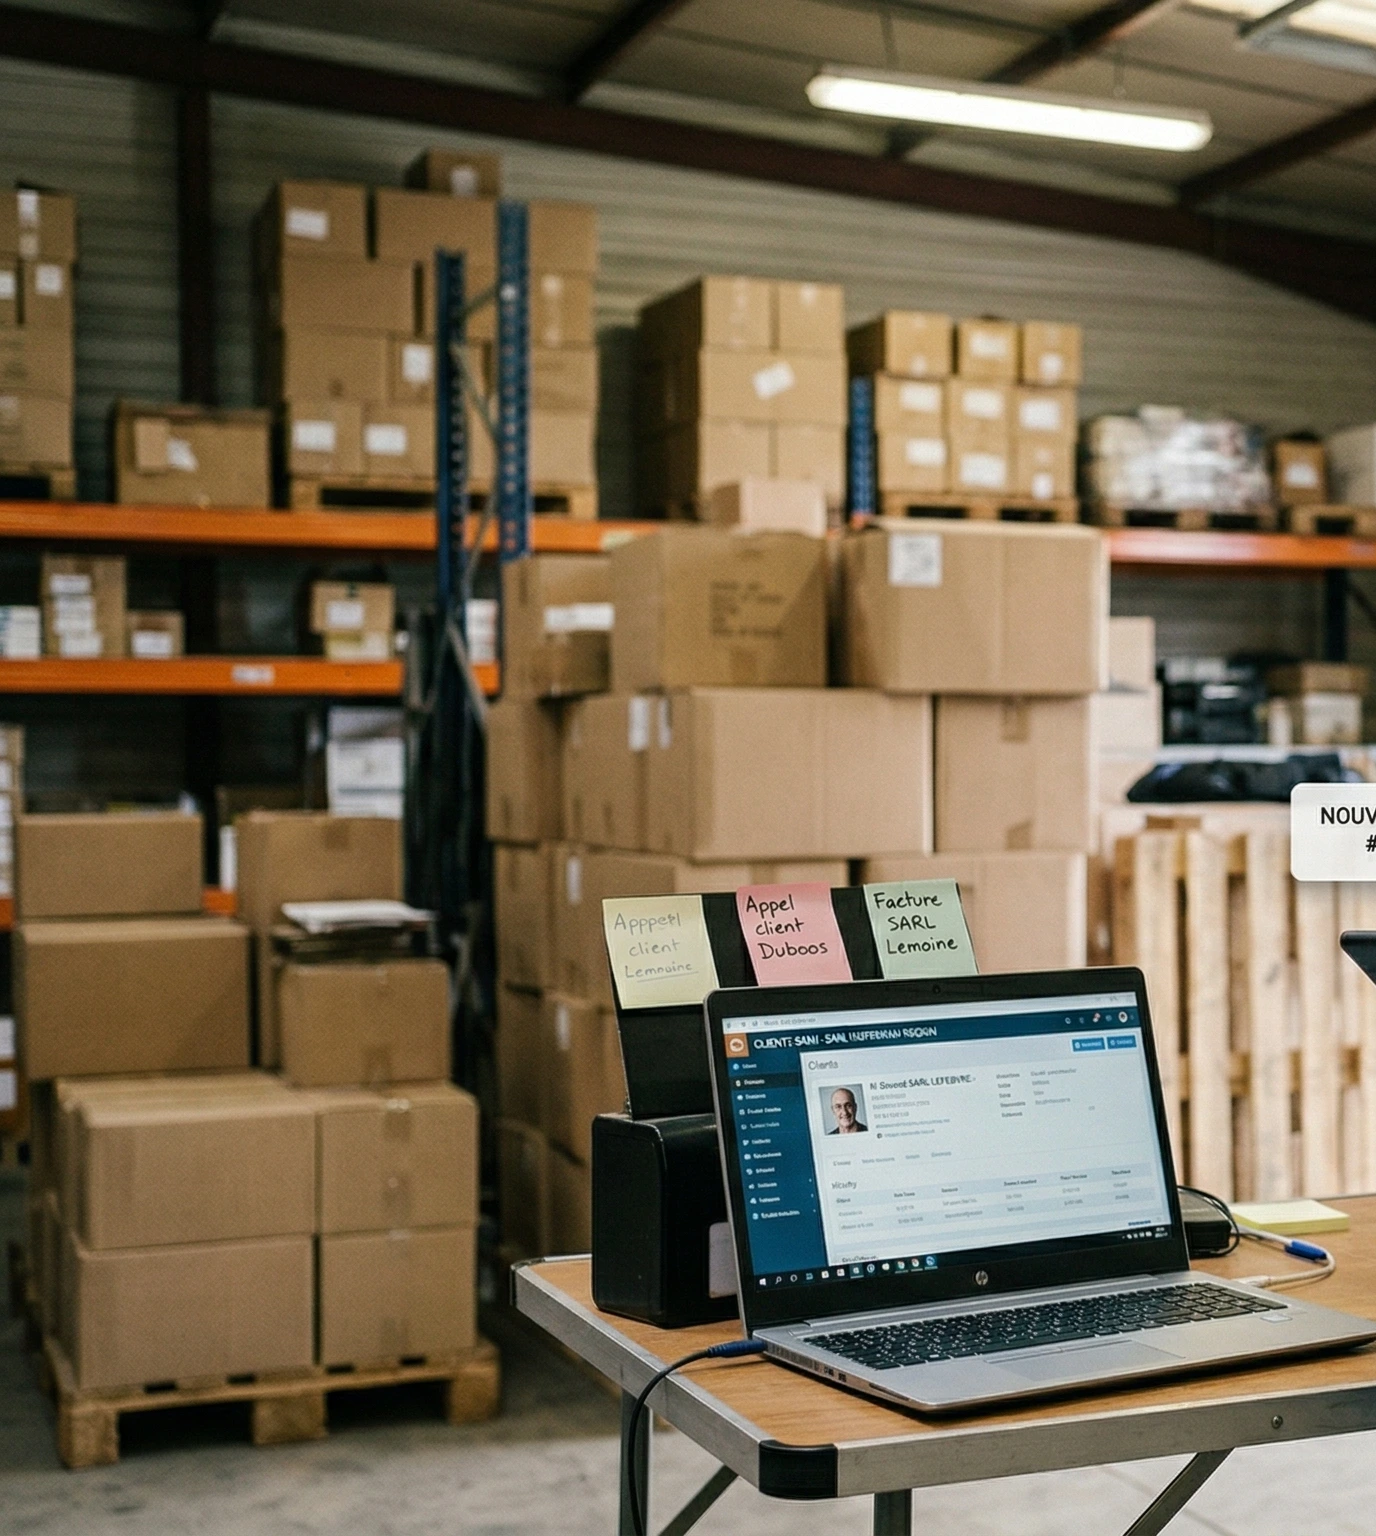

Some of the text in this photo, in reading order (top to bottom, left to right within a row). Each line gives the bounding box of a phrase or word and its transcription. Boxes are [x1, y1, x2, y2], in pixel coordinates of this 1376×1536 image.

[745, 894, 795, 919] Appel
[873, 891, 943, 909] Facture
[755, 918, 805, 936] client
[888, 914, 937, 932] SARL
[628, 938, 681, 957] client
[757, 941, 828, 960] Duboos
[887, 937, 958, 955] Lemoine
